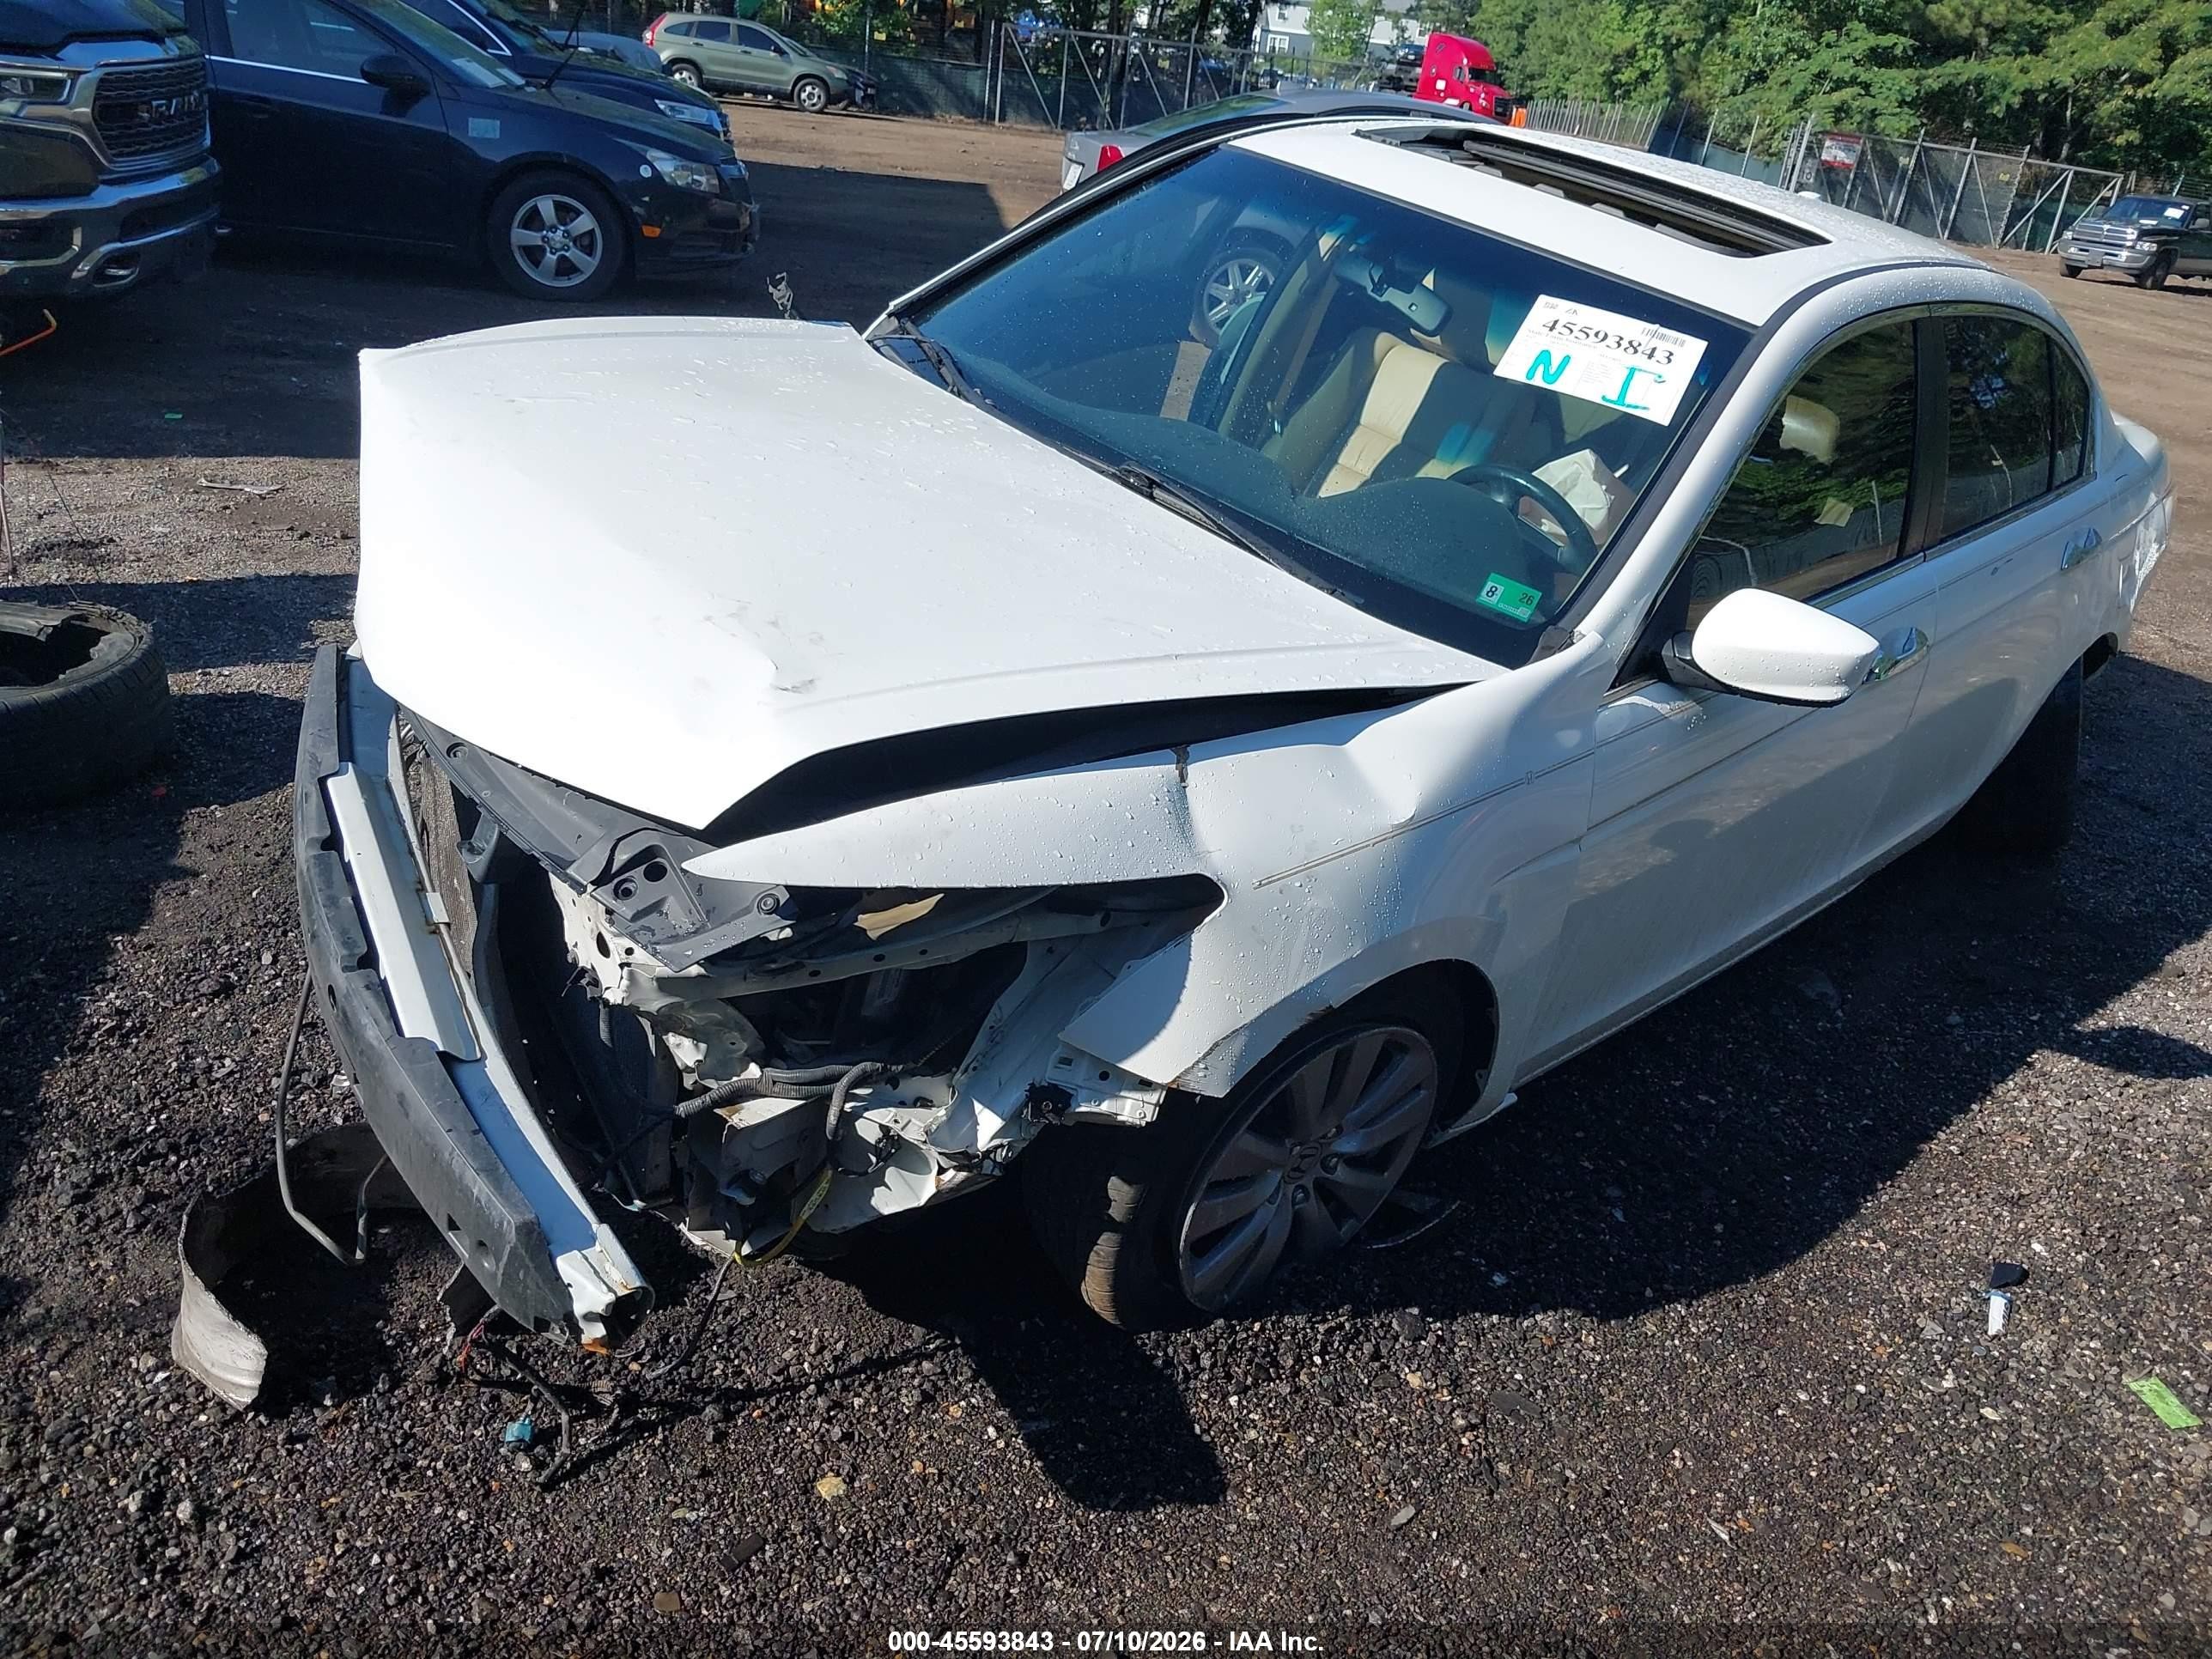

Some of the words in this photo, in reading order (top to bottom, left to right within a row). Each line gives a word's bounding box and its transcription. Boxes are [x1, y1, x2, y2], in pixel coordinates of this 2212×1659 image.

[1542, 319, 1674, 365] 45593843
[1526, 349, 1571, 385] N
[1486, 586, 1498, 598] 8
[1519, 592, 1534, 605] 26
